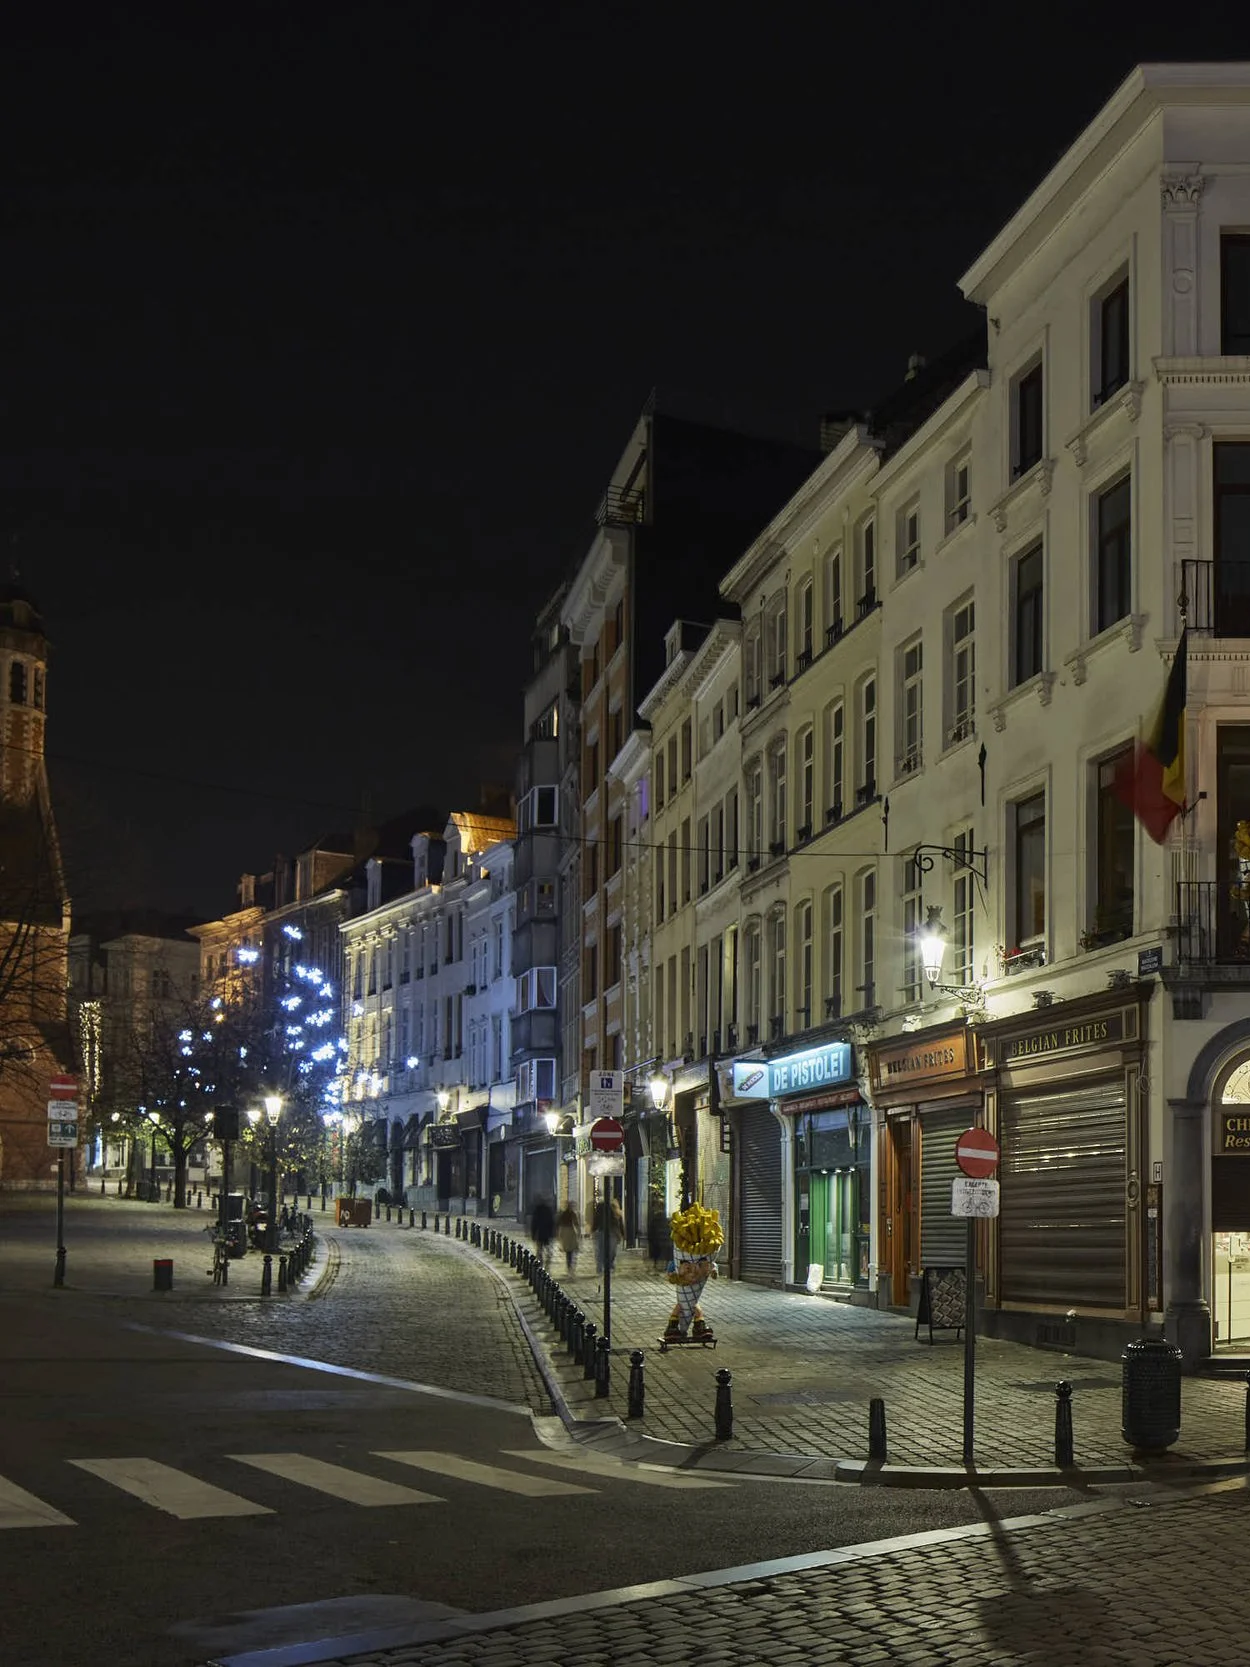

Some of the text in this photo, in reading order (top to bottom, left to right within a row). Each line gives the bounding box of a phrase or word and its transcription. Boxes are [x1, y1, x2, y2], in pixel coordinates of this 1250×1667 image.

[1012, 1022, 1107, 1056] BELGIAN FRITES
[887, 1048, 954, 1074] BELGIAN FRITES
[773, 1066, 788, 1091] DE
